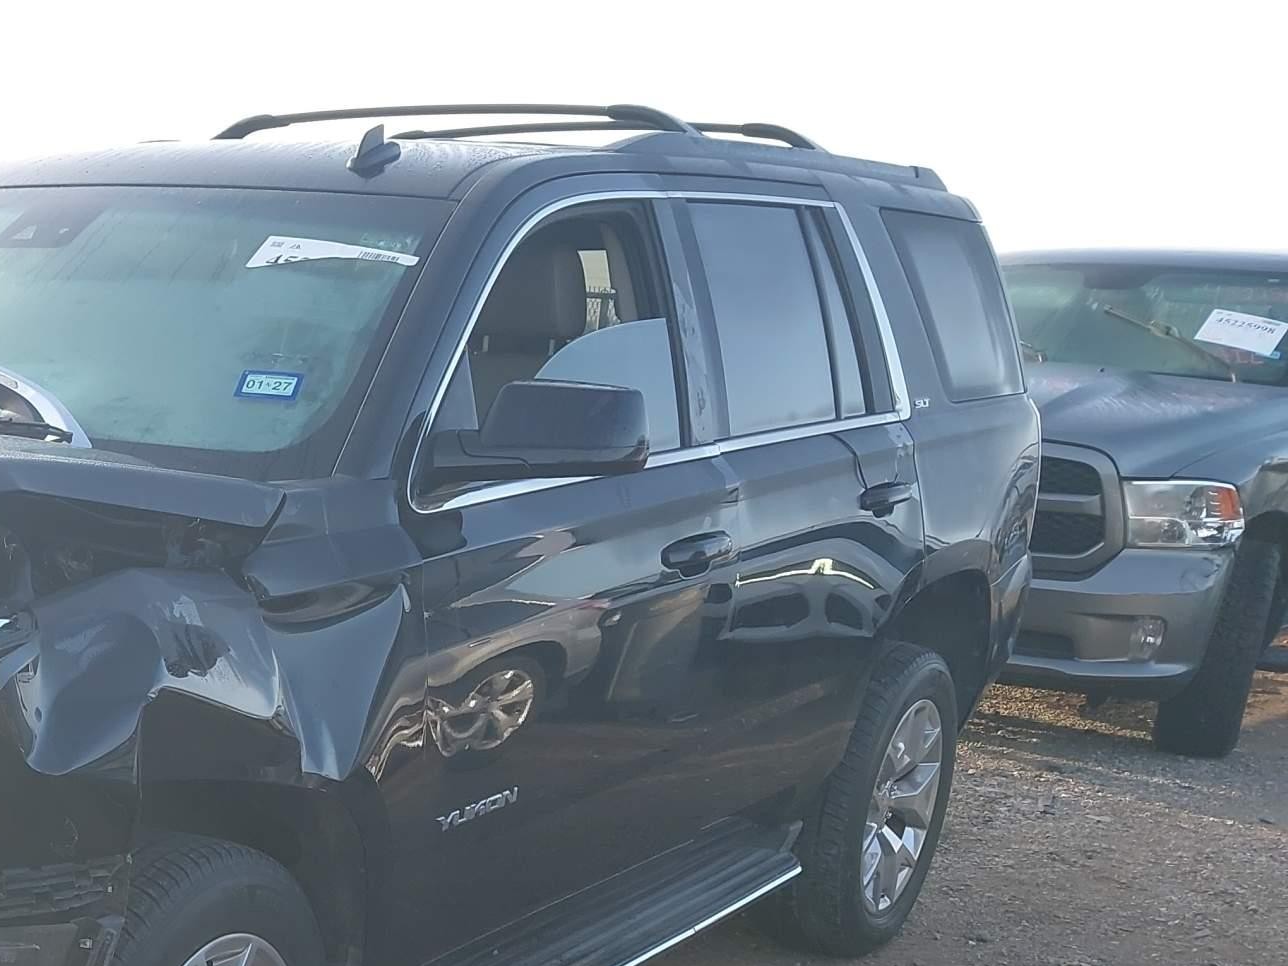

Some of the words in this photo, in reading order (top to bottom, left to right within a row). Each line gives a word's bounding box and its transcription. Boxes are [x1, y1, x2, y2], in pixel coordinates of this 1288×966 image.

[271, 380, 293, 391] 27
[915, 398, 931, 409] SLT
[435, 786, 519, 832] YUKON
